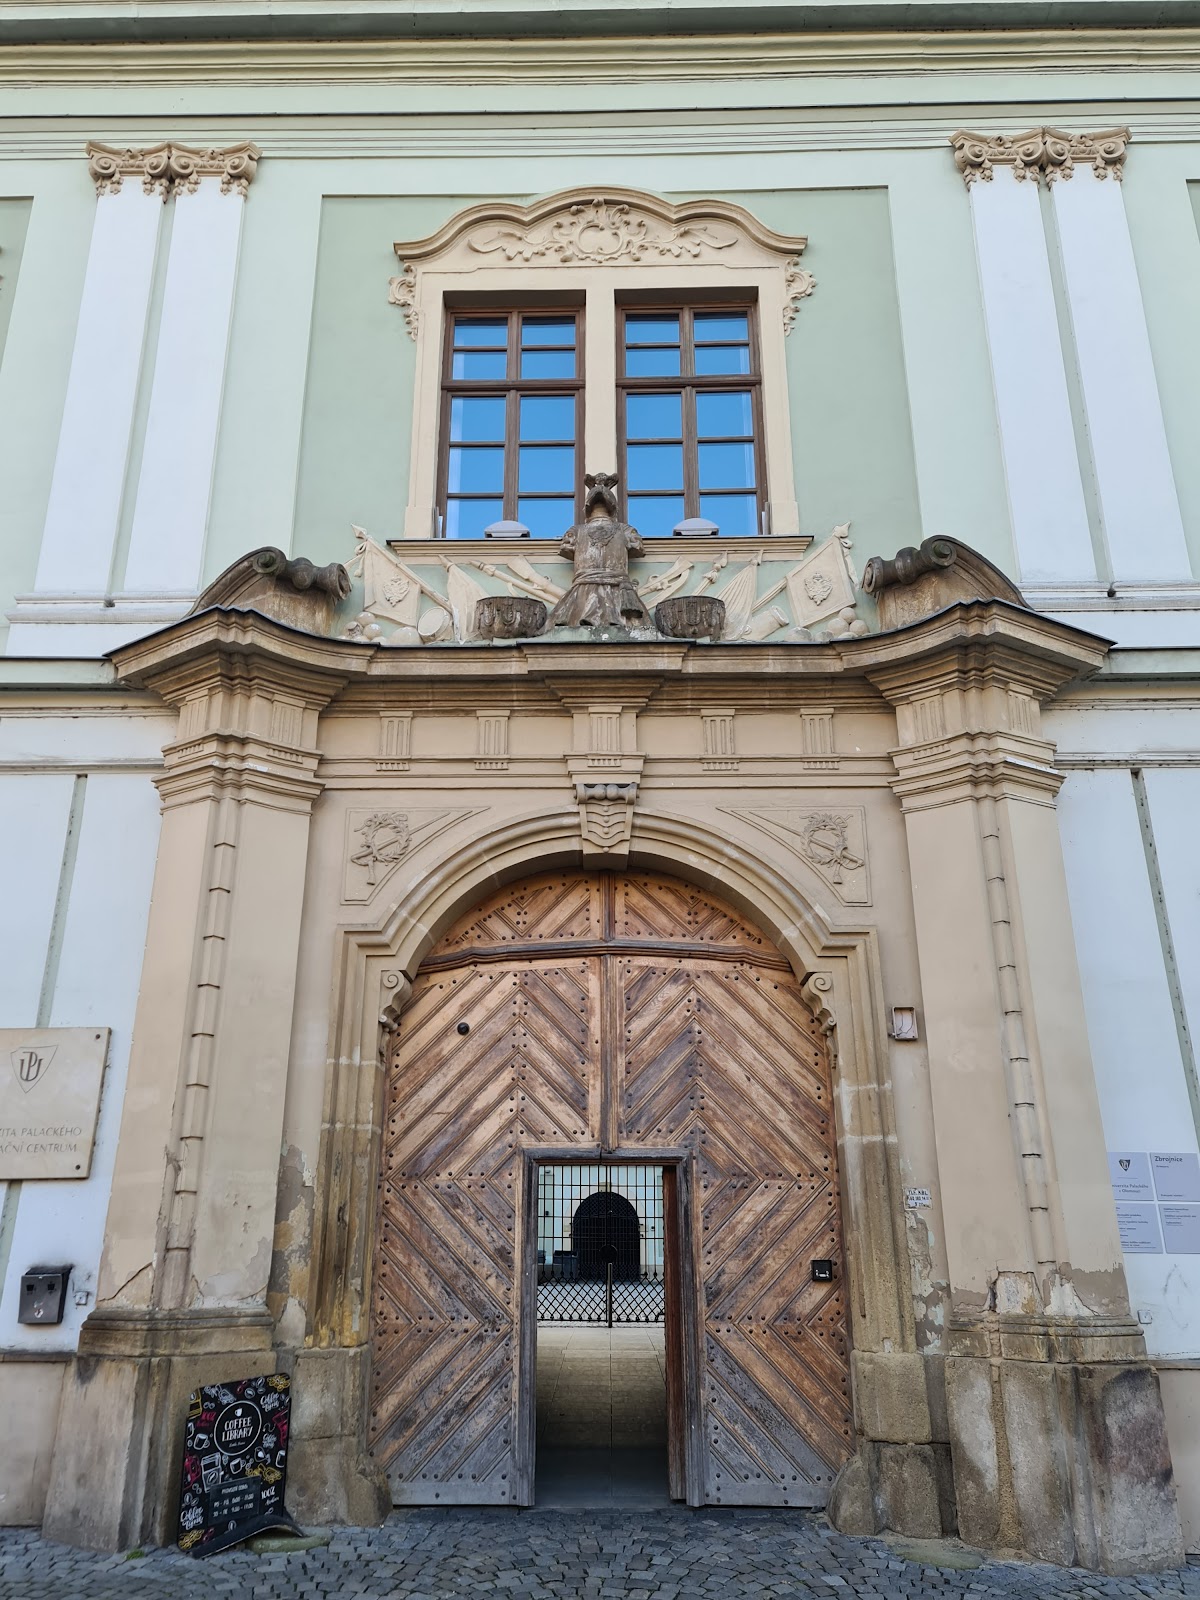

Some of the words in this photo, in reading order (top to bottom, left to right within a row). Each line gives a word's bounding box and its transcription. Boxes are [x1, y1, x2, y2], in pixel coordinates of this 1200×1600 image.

[21, 1125, 82, 1137] PALACKÉHO
[26, 1143, 77, 1153] CENTRUM
[1154, 1155, 1183, 1163] Zbrojnice
[224, 1416, 252, 1431] COFFEE
[222, 1426, 253, 1442] LIBRARY
